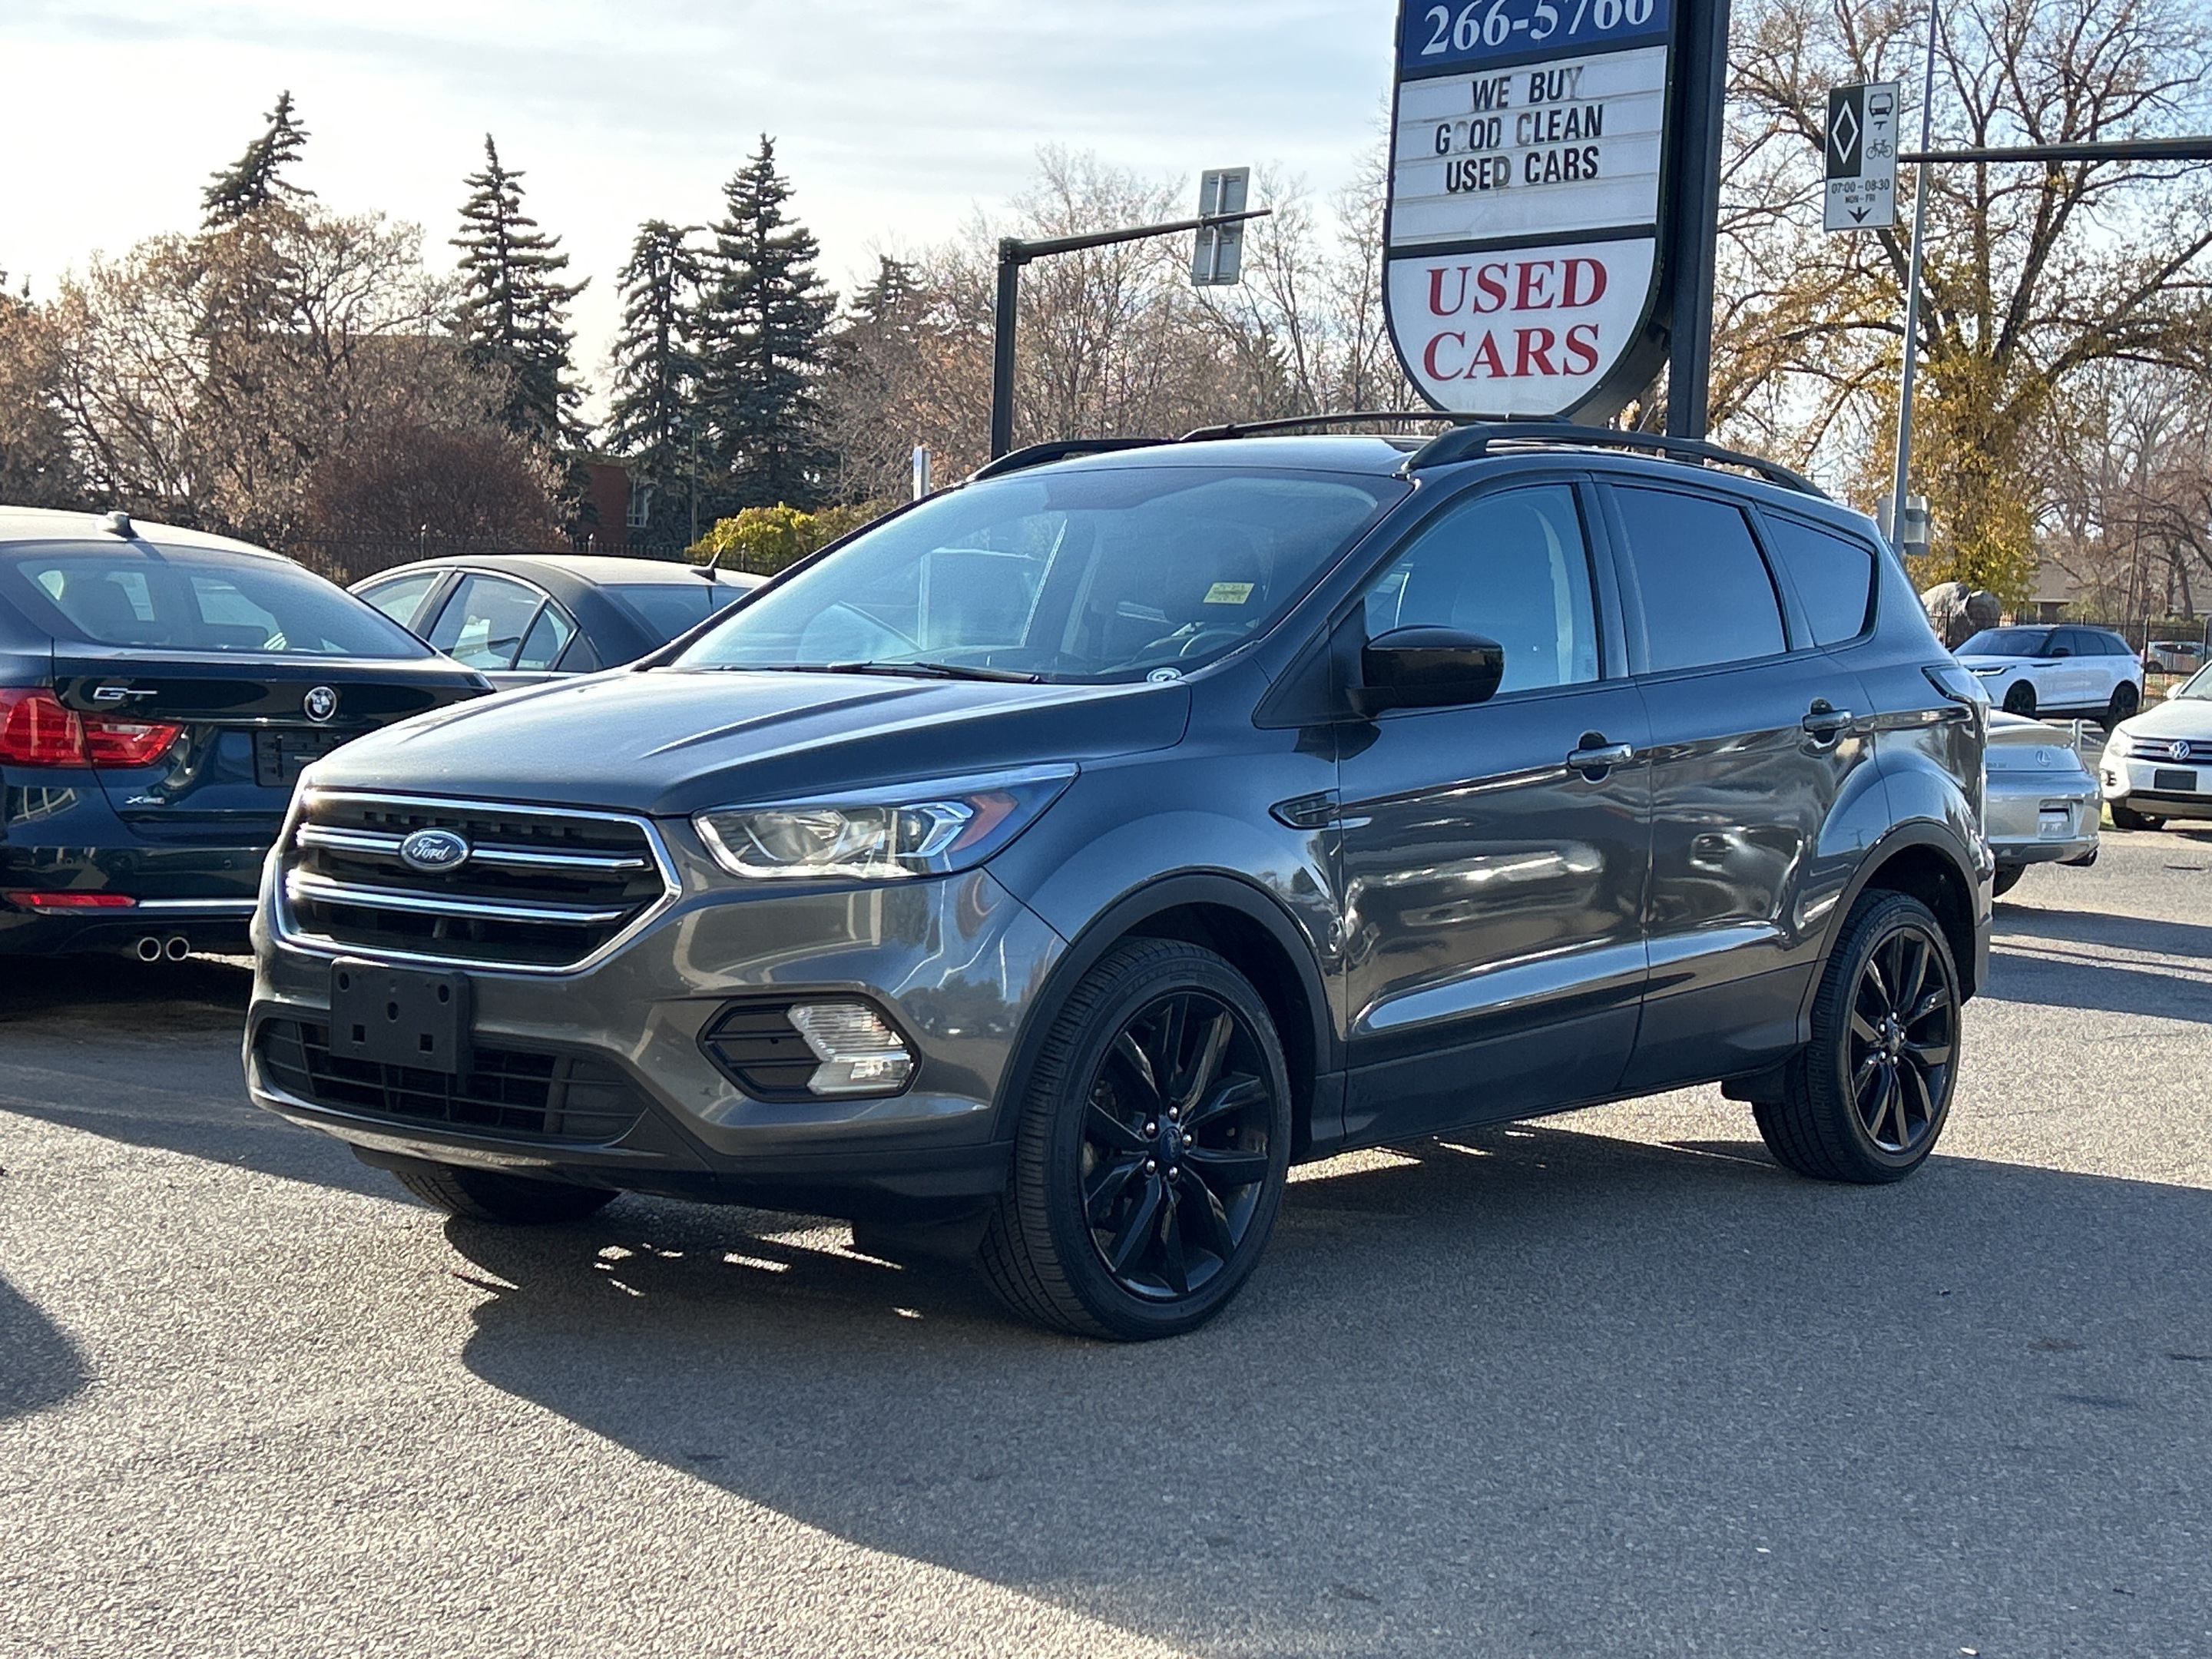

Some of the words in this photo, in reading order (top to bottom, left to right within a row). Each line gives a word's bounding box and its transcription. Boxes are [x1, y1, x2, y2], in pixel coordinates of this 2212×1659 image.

[1472, 75, 1512, 111] WE
[1528, 66, 1584, 104] BUY
[1516, 104, 1604, 147] CLEAN
[1446, 155, 1512, 192] USED
[1525, 145, 1599, 184] CARS
[1426, 258, 1608, 316] USED
[1423, 323, 1599, 382] CARS
[412, 837, 451, 860] Ford
